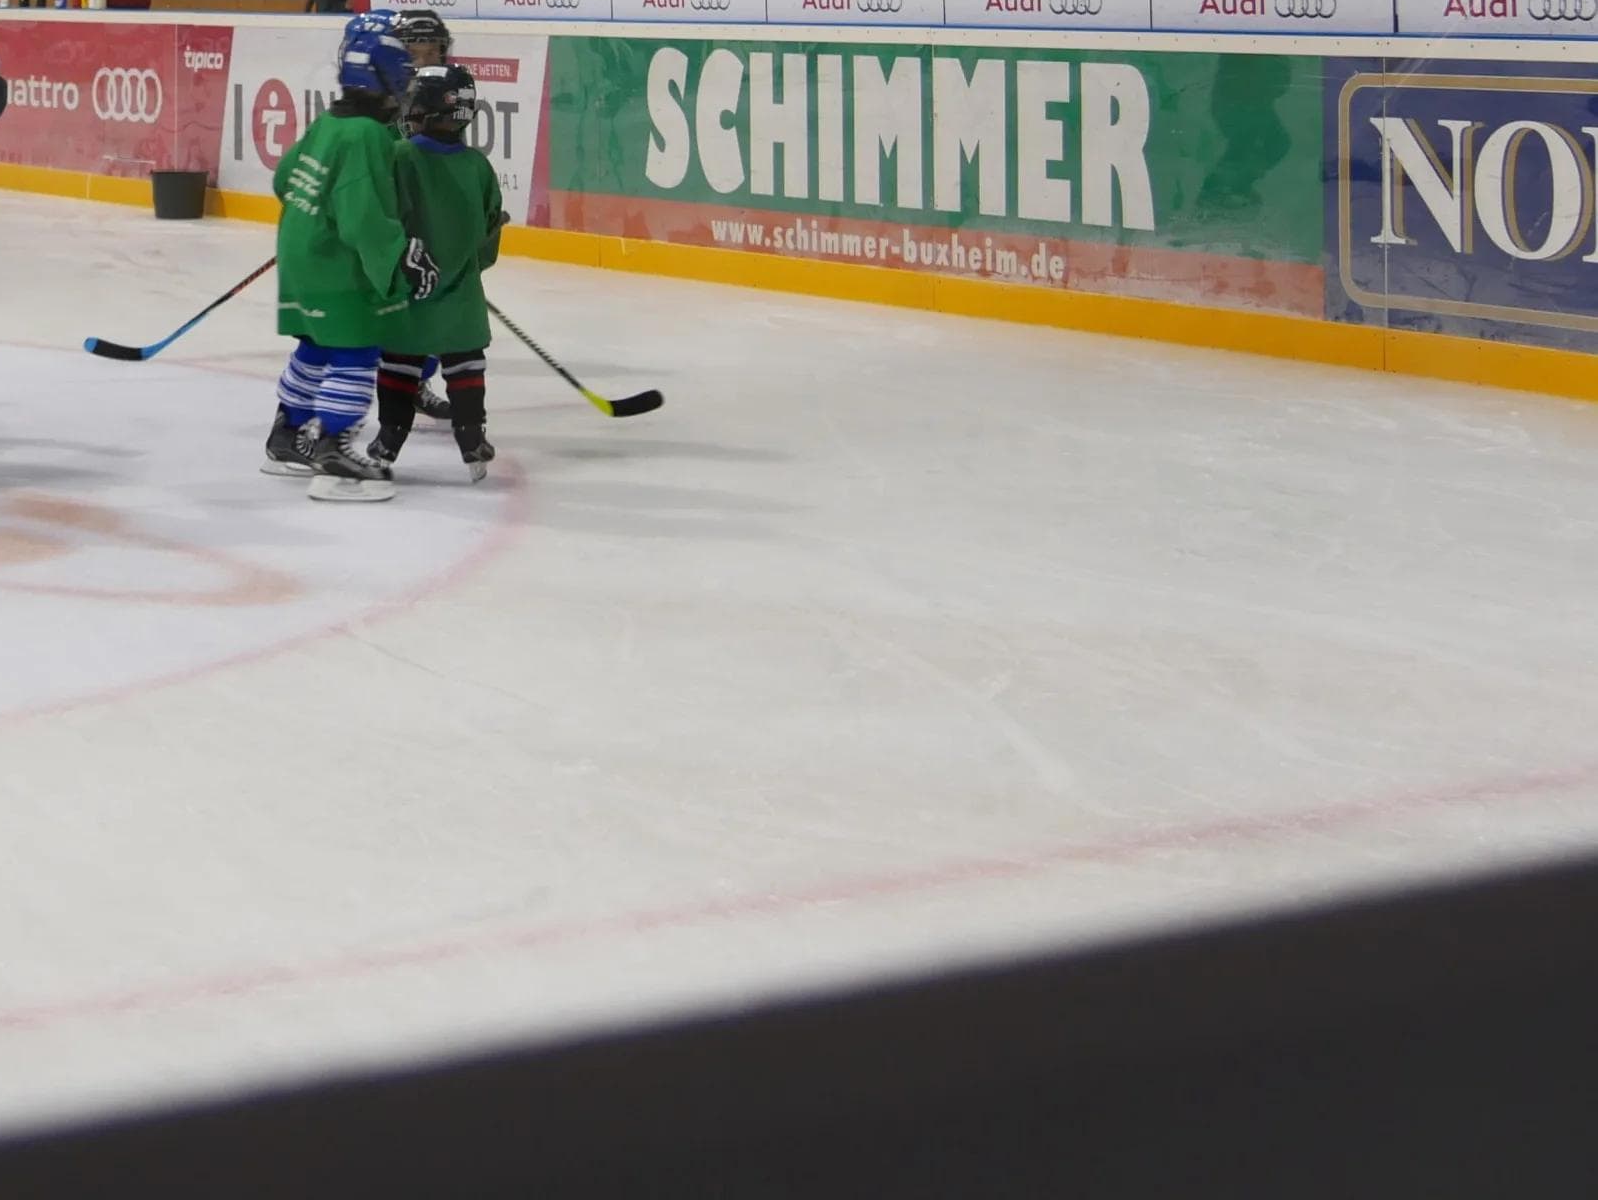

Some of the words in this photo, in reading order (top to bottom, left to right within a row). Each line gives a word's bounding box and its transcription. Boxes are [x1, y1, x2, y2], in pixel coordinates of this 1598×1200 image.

[183, 46, 224, 72] tipico
[478, 63, 512, 78] WETTEN.
[7, 75, 79, 111] attro
[644, 46, 1155, 232] SCHIMMER
[1368, 116, 1598, 263] NO
[711, 218, 1066, 282] www.schimmer-buxheim.de
